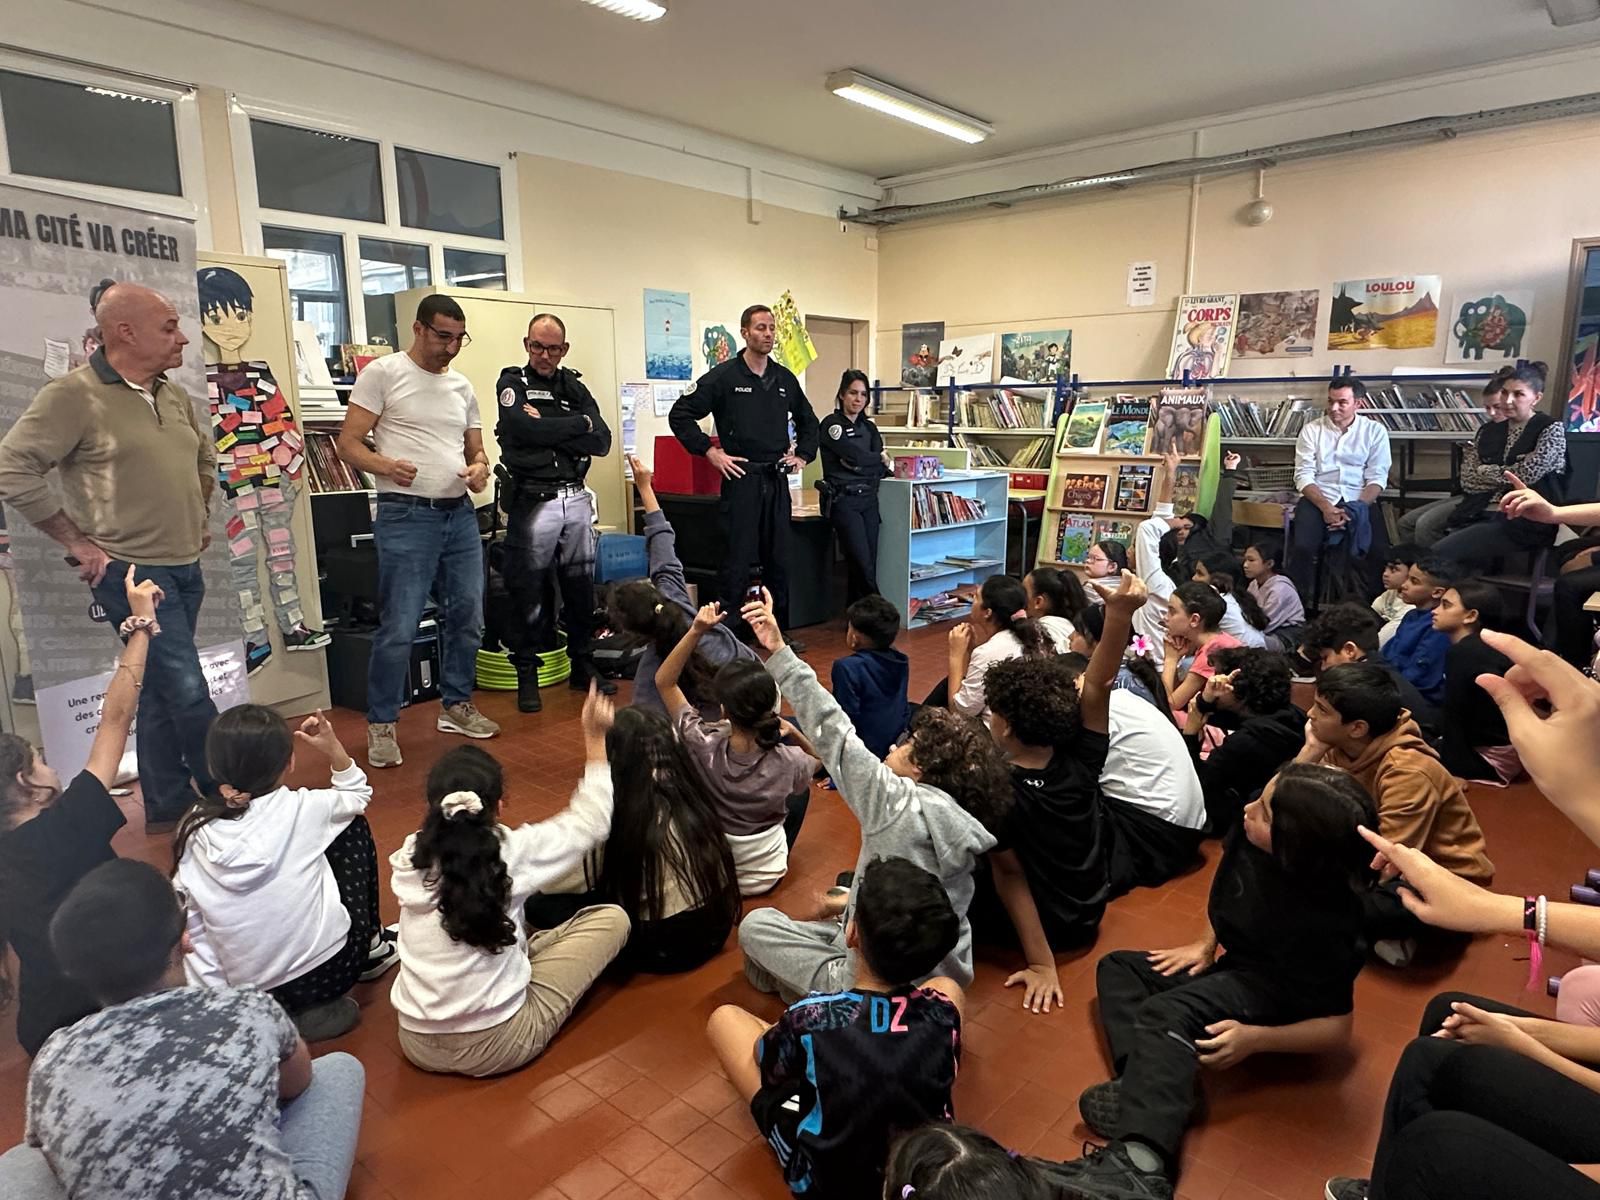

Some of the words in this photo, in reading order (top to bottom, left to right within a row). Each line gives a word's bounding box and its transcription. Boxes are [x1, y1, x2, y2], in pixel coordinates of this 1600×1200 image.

[0, 207, 30, 240] MA
[36, 213, 83, 248] CITÉ
[87, 221, 117, 253] VA
[121, 226, 180, 262] CRÉER
[1366, 281, 1415, 293] LOULOU
[1187, 307, 1232, 322] CORPS
[1160, 395, 1205, 405] ANIMAUX
[1065, 518, 1091, 528] ATLAS
[68, 697, 88, 707] Une
[210, 660, 229, 669] avec
[75, 711, 94, 721] des
[871, 996, 908, 1033] DZ
